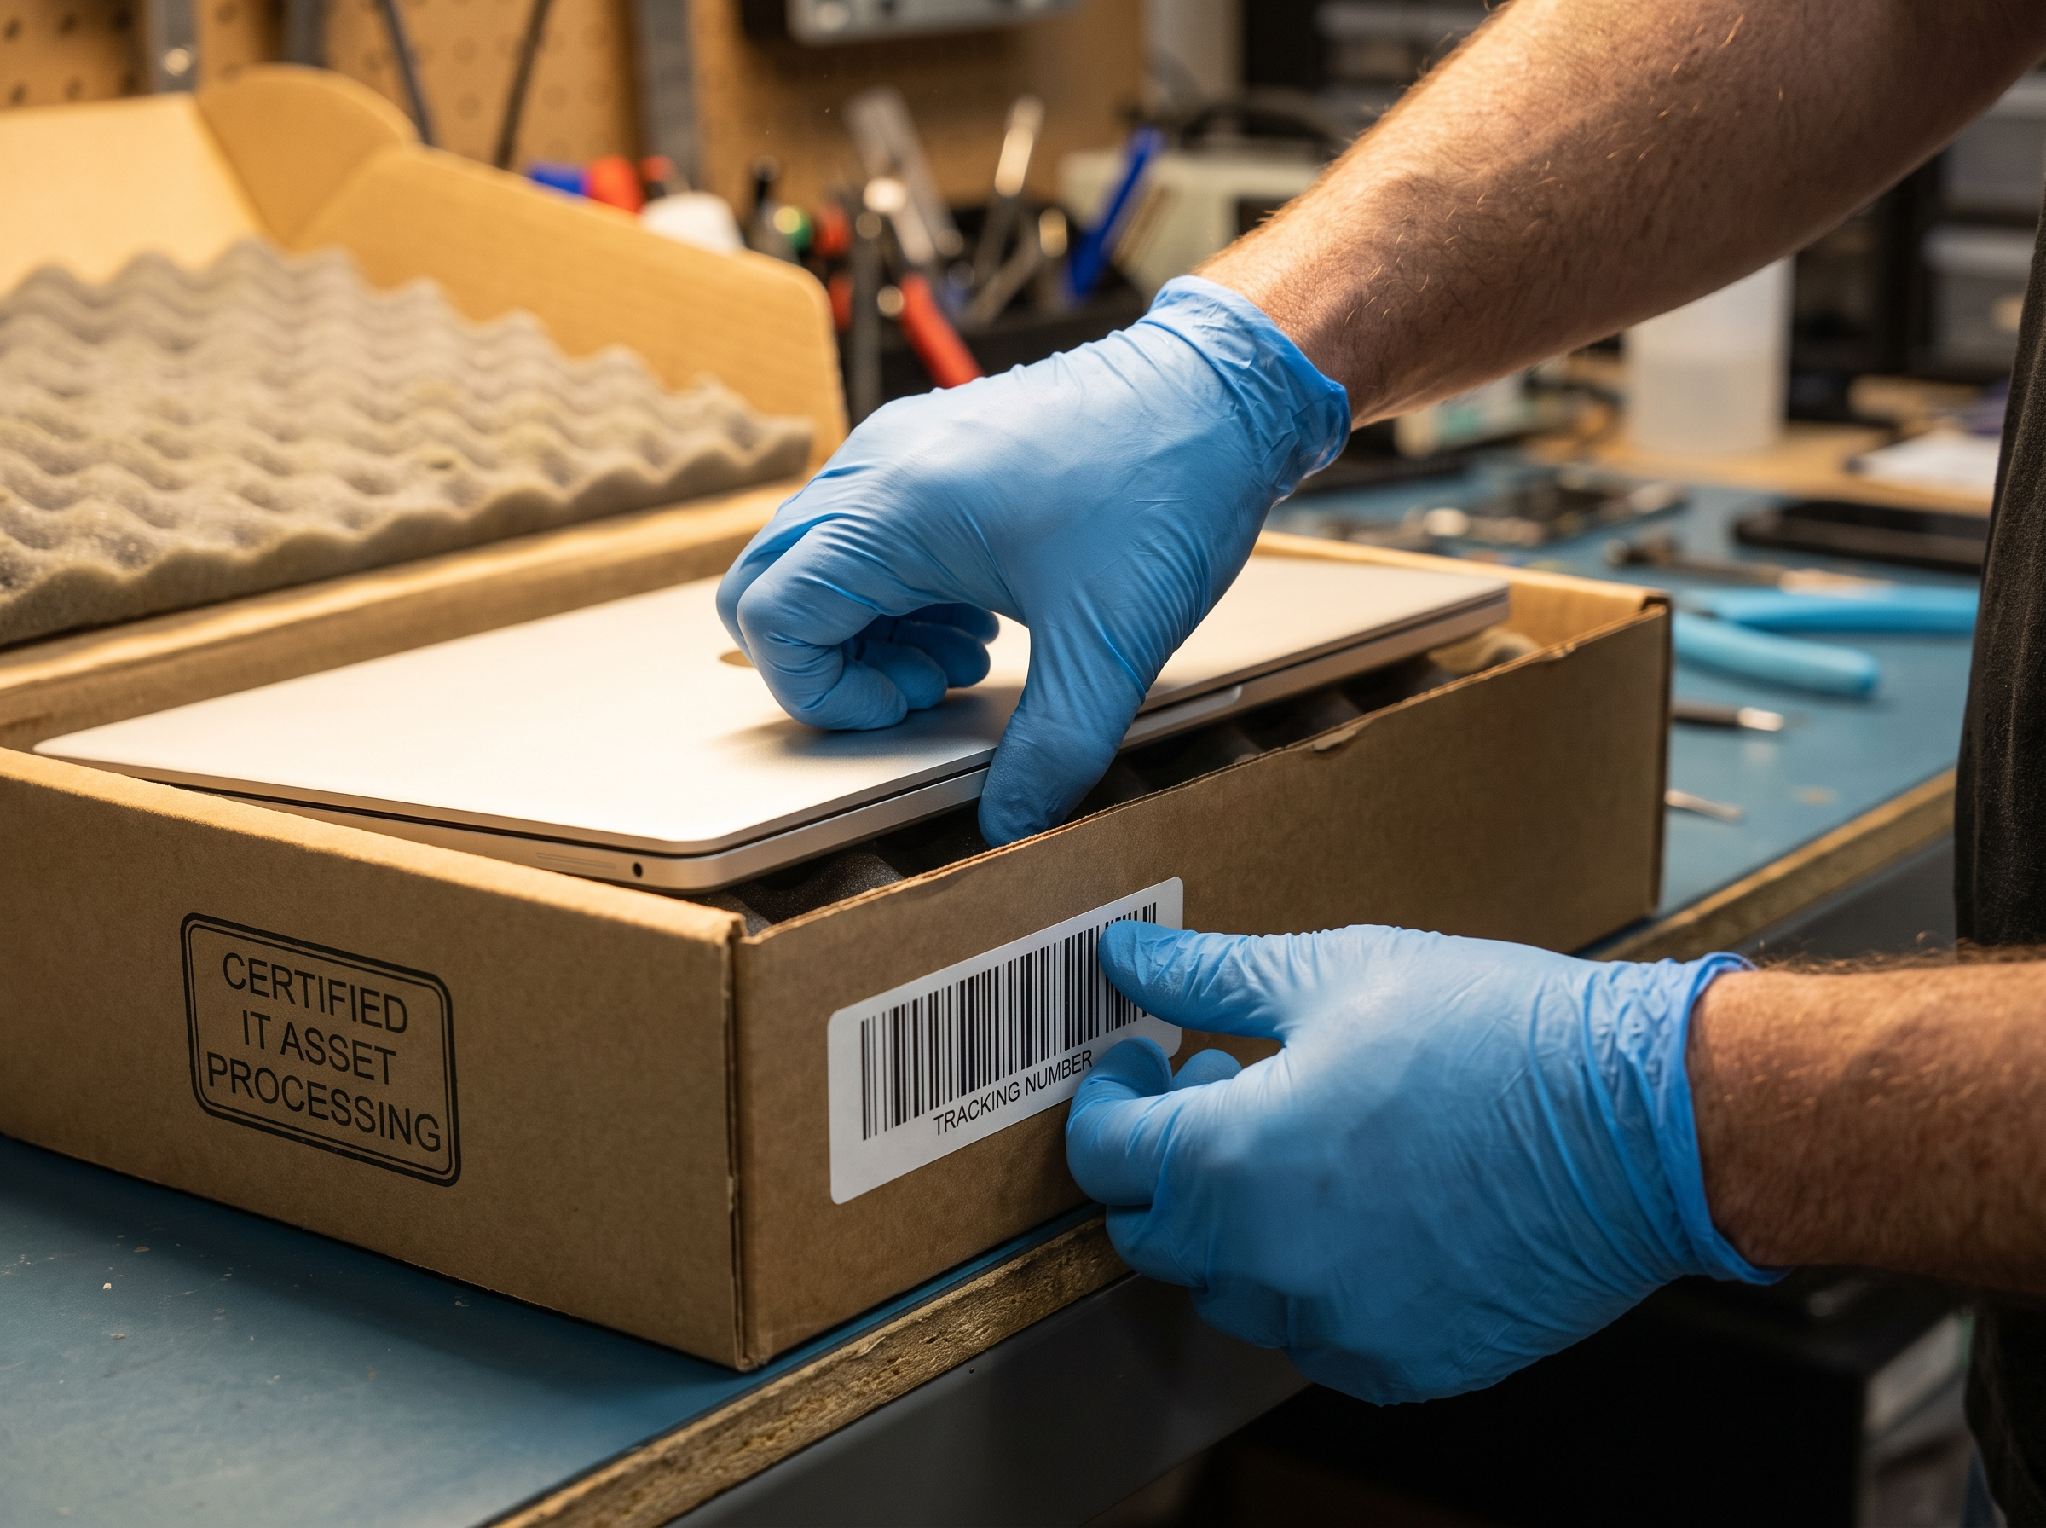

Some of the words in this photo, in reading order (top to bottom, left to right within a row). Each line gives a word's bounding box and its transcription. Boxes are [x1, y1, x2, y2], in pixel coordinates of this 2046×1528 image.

[222, 952, 408, 1034] CERTIFIED
[242, 1009, 271, 1050] IT
[279, 1021, 397, 1086] ASSET
[206, 1050, 441, 1153] PROCESSING
[932, 1081, 1021, 1136] TRACKING
[1025, 1049, 1093, 1096] NUMBER
